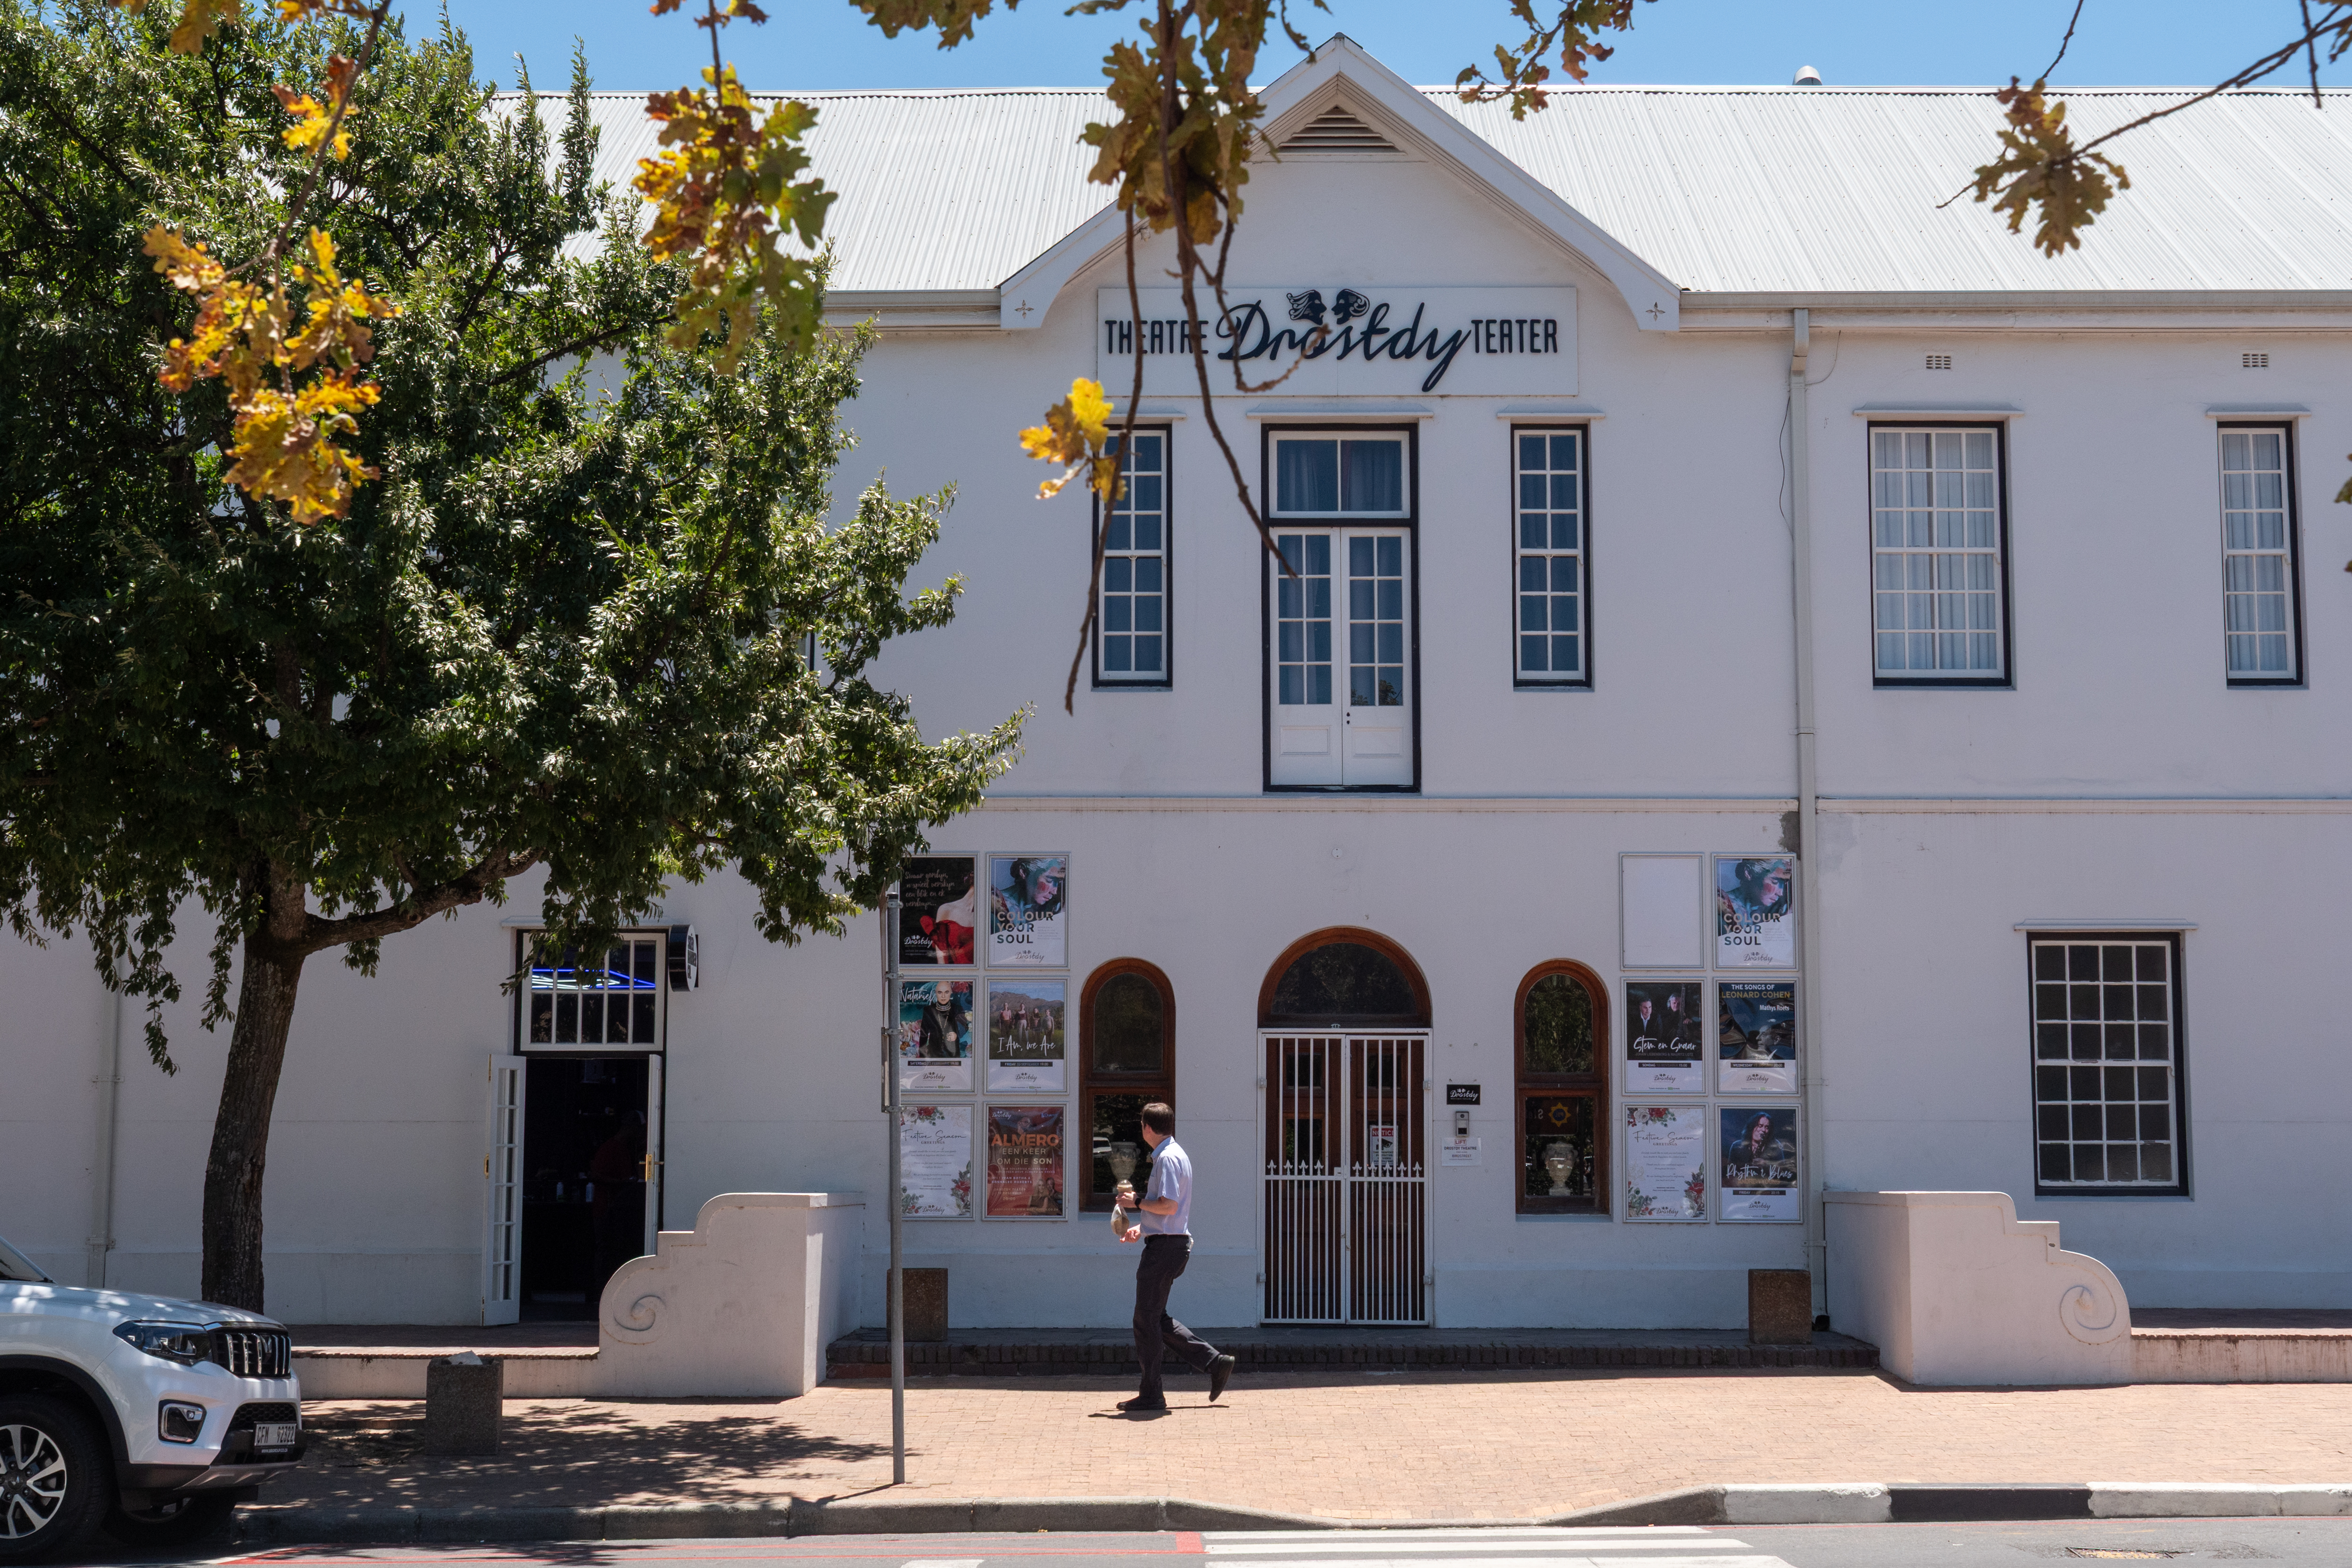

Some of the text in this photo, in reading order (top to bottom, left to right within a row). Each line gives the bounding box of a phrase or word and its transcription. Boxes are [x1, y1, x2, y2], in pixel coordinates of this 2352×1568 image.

[1216, 299, 1472, 393] Drostdy
[1471, 319, 1558, 354] TEATER
[997, 911, 1054, 921] COLOUR
[1723, 913, 1781, 922] COLOUR
[997, 923, 1035, 932] YOUR
[1723, 925, 1762, 934] YOUR
[904, 937, 934, 948] Drostdy
[997, 934, 1034, 944] SOUL
[1724, 936, 1761, 946] SOUL
[1015, 952, 1045, 963] Drostdy
[1743, 954, 1773, 965] Drostdy
[997, 1035, 1056, 1056] I Am, we Are
[1633, 1035, 1657, 1053] Stem
[923, 1073, 945, 1082] Drostdy
[1015, 1074, 1037, 1082] Drostdy
[1654, 1074, 1676, 1083] Drostdy
[1746, 1075, 1769, 1084] Drostdy
[1450, 1090, 1479, 1101] Drostdy
[901, 1129, 967, 1142] Festive Season
[991, 1134, 1059, 1146] ALMERO
[1632, 1130, 1699, 1144] Festive Season
[1726, 1163, 1759, 1180] Rhythm
[1768, 1164, 1793, 1180] Blues
[922, 1207, 945, 1215] Drostdy
[1748, 1203, 1771, 1211] Drostdy
[1656, 1208, 1679, 1217] Drostdy
[277, 1426, 294, 1443] 92322
